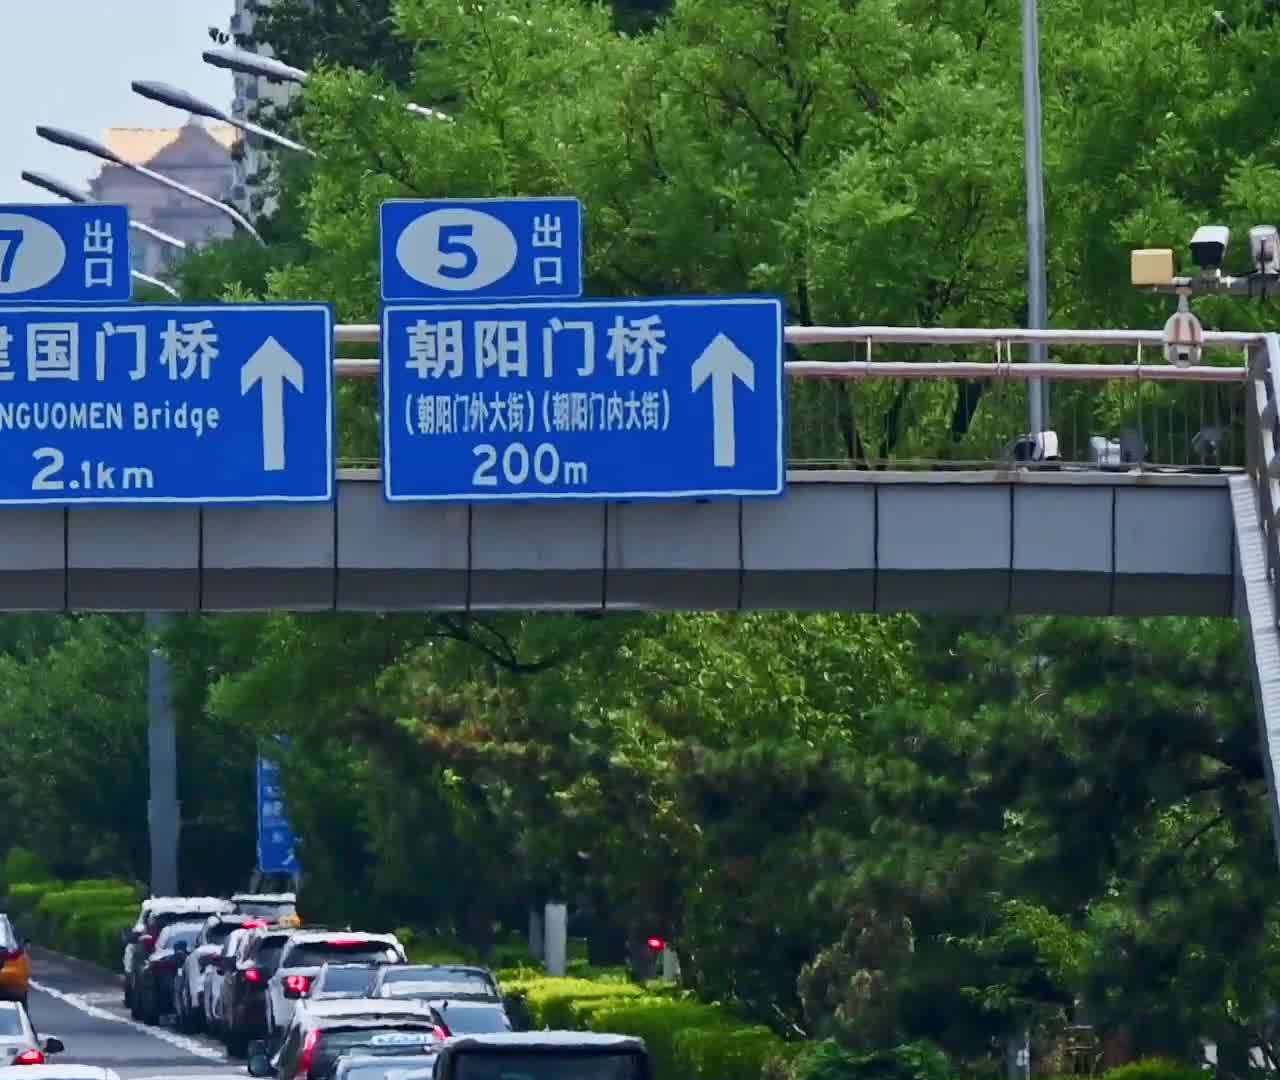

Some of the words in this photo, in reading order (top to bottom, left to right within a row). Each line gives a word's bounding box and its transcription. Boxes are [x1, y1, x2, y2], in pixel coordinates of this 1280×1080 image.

[83, 219, 114, 288] 出口
[437, 224, 478, 280] 5
[532, 213, 562, 285] 出口
[404, 313, 667, 379] 朝阳门桥
[133, 401, 219, 437] Bridge
[31, 447, 153, 490] 2.1km
[473, 442, 587, 486] 200m
